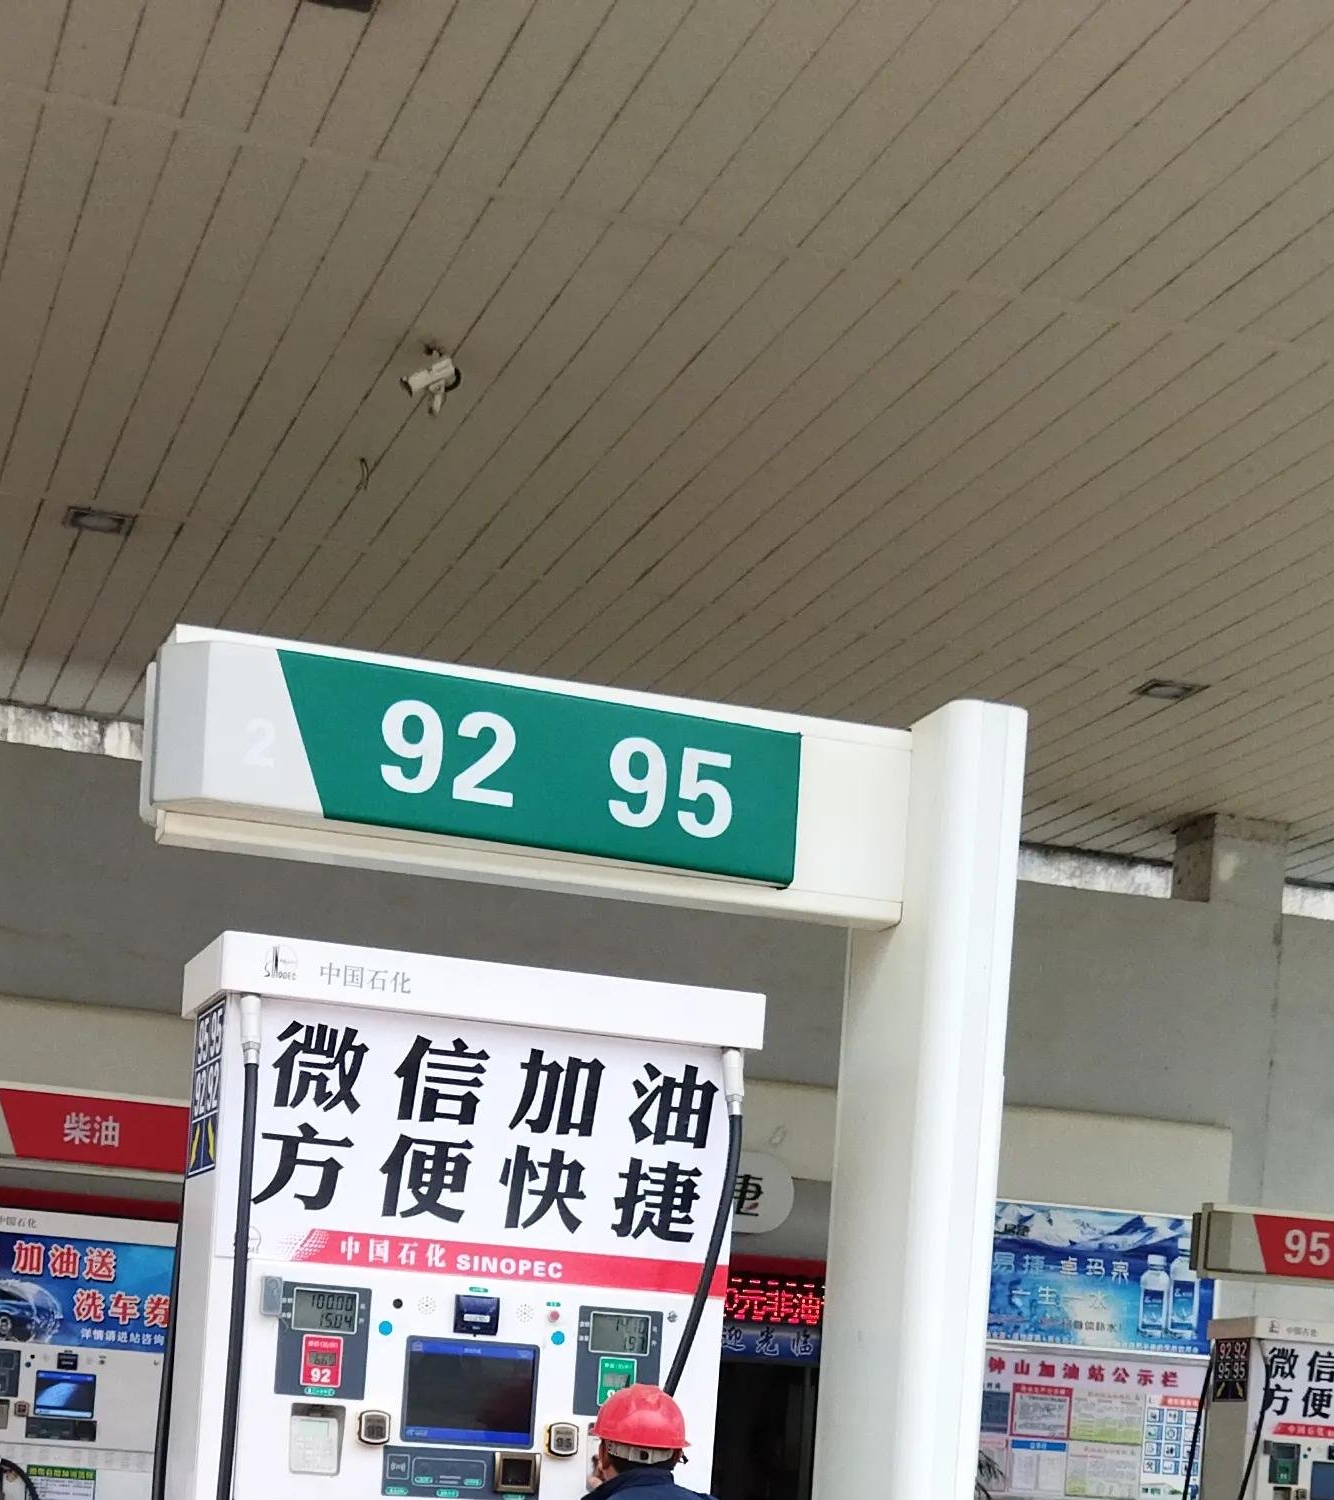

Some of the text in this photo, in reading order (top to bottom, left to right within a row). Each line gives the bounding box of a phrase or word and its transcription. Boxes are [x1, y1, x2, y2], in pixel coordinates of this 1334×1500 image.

[380, 699, 734, 839] 92 95
[319, 961, 412, 995] 中国石化
[271, 1019, 720, 1150] 微信加油
[62, 1111, 121, 1149] 柴油
[251, 1121, 704, 1244] 方便快捷
[11, 1240, 118, 1283] 加油送
[339, 1235, 564, 1280] 中国石化 SINOPEC
[1283, 1229, 1332, 1267] 95
[72, 1288, 171, 1329] 洗车券
[80, 1327, 166, 1347] 详情请进站咨询
[1219, 1342, 1232, 1360] 92
[1234, 1341, 1247, 1359] 92
[310, 1367, 331, 1383] 92
[988, 1356, 1180, 1388] 钟山加油站公示栏
[1217, 1361, 1246, 1379] 95 95
